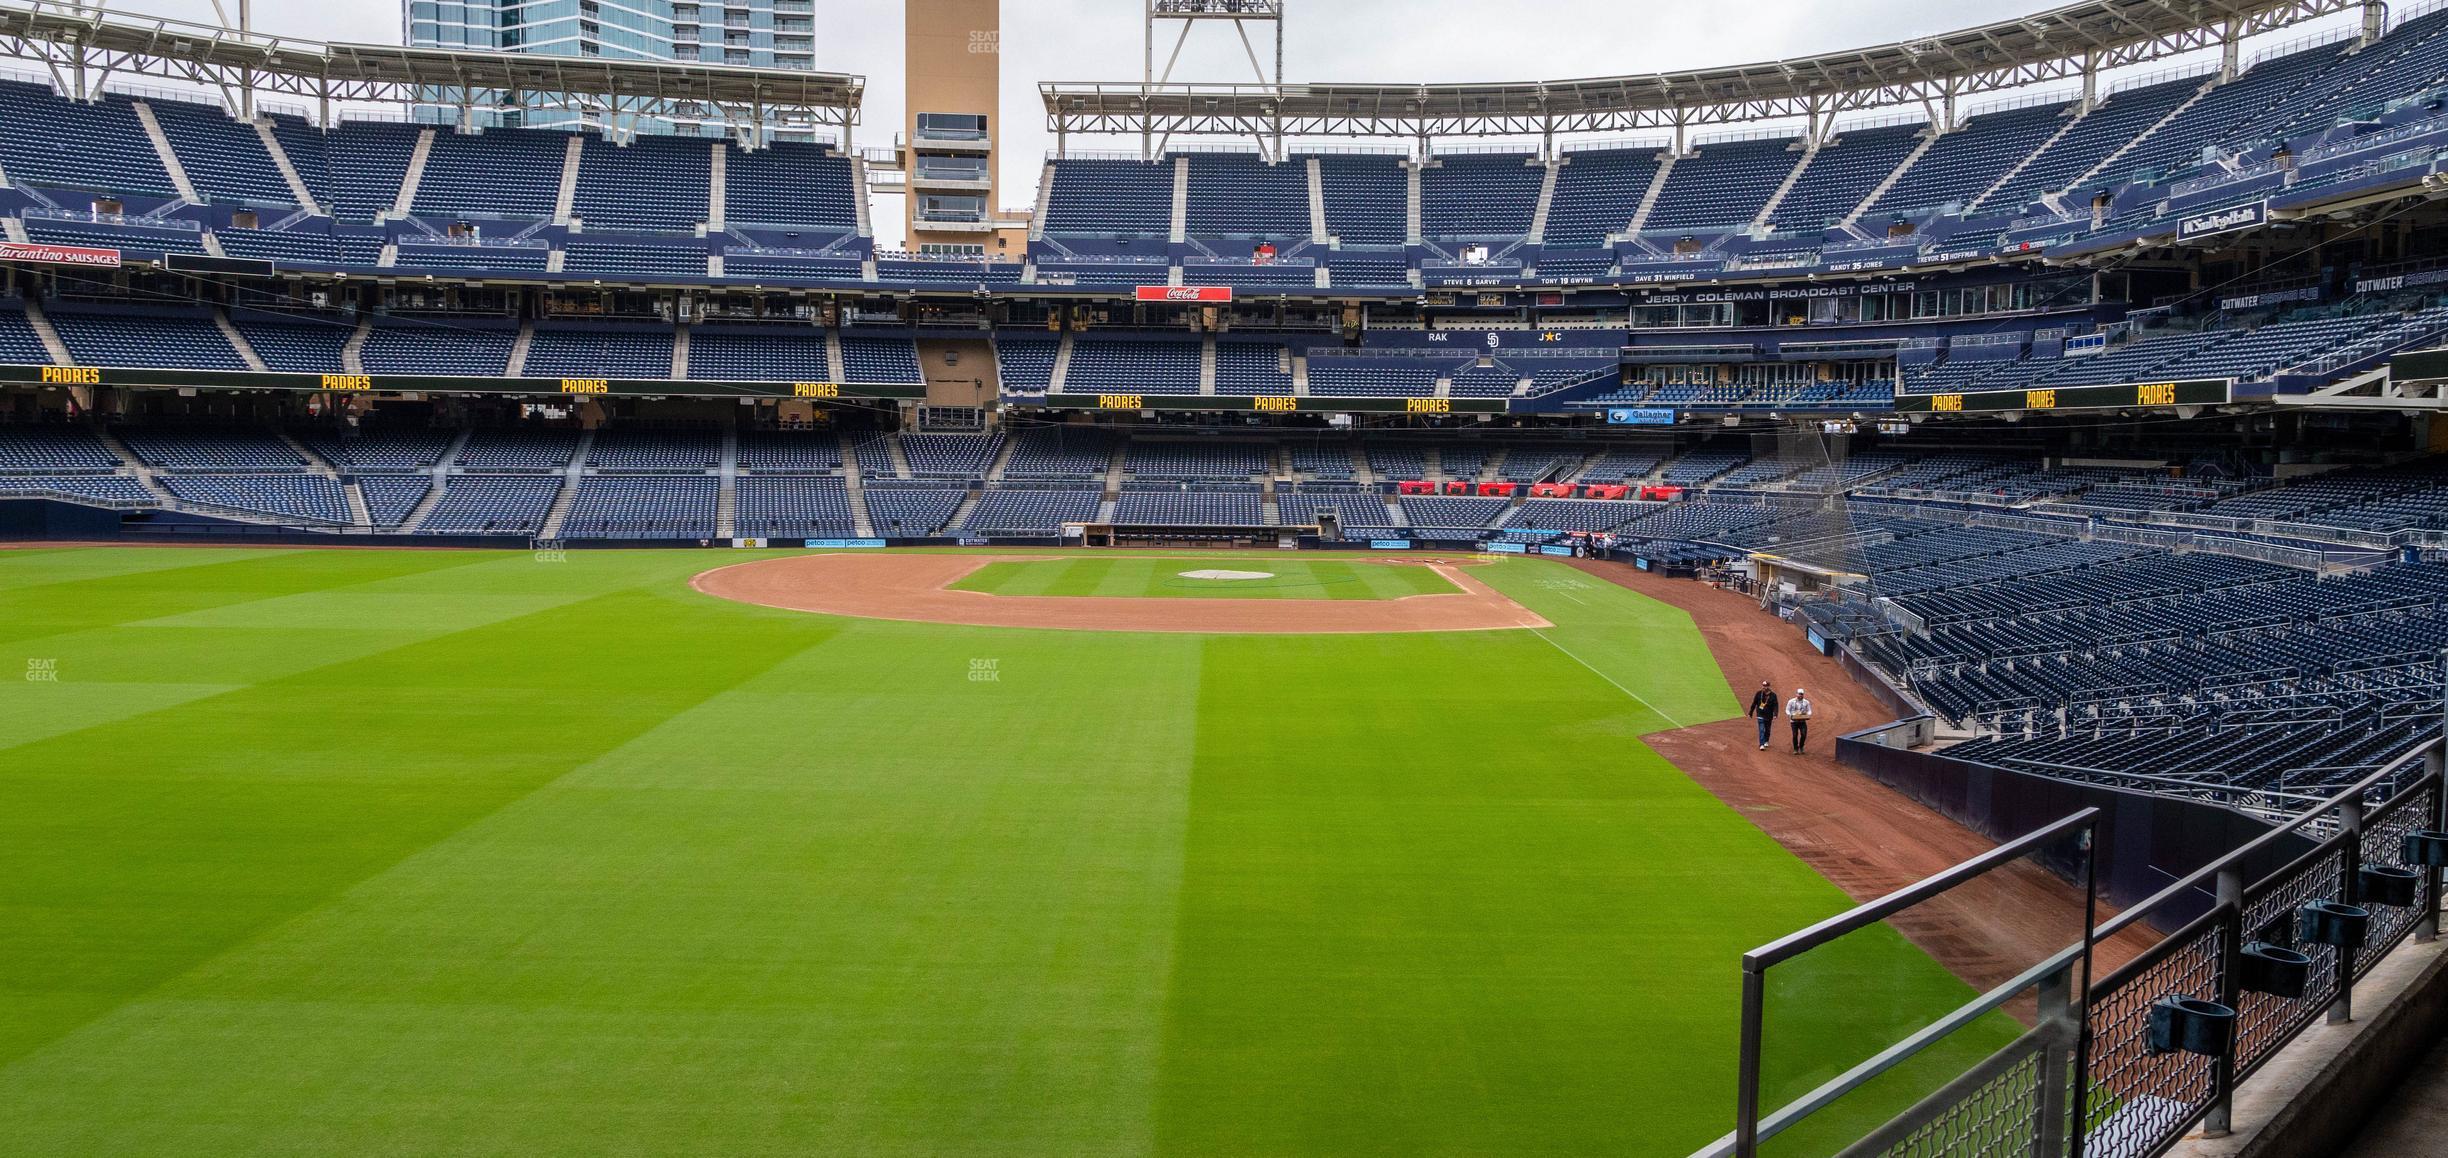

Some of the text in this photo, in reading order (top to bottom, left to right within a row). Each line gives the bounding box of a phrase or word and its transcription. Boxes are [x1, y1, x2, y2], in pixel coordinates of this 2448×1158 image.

[65, 253, 119, 265] SAUSAGES
[1917, 250, 1978, 264] TREVOR 51 HOFFMAN
[1829, 261, 1883, 271] RANDY 35 JONES
[1466, 278, 1472, 286] 6
[1560, 277, 1568, 285] 19
[1664, 273, 1695, 281] WINFIELD
[2355, 275, 2403, 293] CUTWATER
[1645, 282, 1915, 304] JERRY COLEMAN BROADCAST CENTER
[2221, 295, 2259, 310] CUTWATER
[1428, 333, 1448, 341] RAK
[41, 367, 100, 384] PADRES
[321, 374, 371, 390] PADRES
[561, 379, 608, 393] PADRES
[794, 383, 838, 397] PADRES
[2026, 390, 2056, 408] PADRES
[2137, 383, 2175, 405] PADRES
[1100, 395, 1142, 409] PADRES
[1254, 396, 1297, 411] PADRES
[1407, 398, 1450, 412] PADRES
[1932, 394, 1962, 411] PADRES
[1632, 410, 1671, 419] Gallagher
[806, 539, 825, 547] petco
[847, 539, 866, 547] petco
